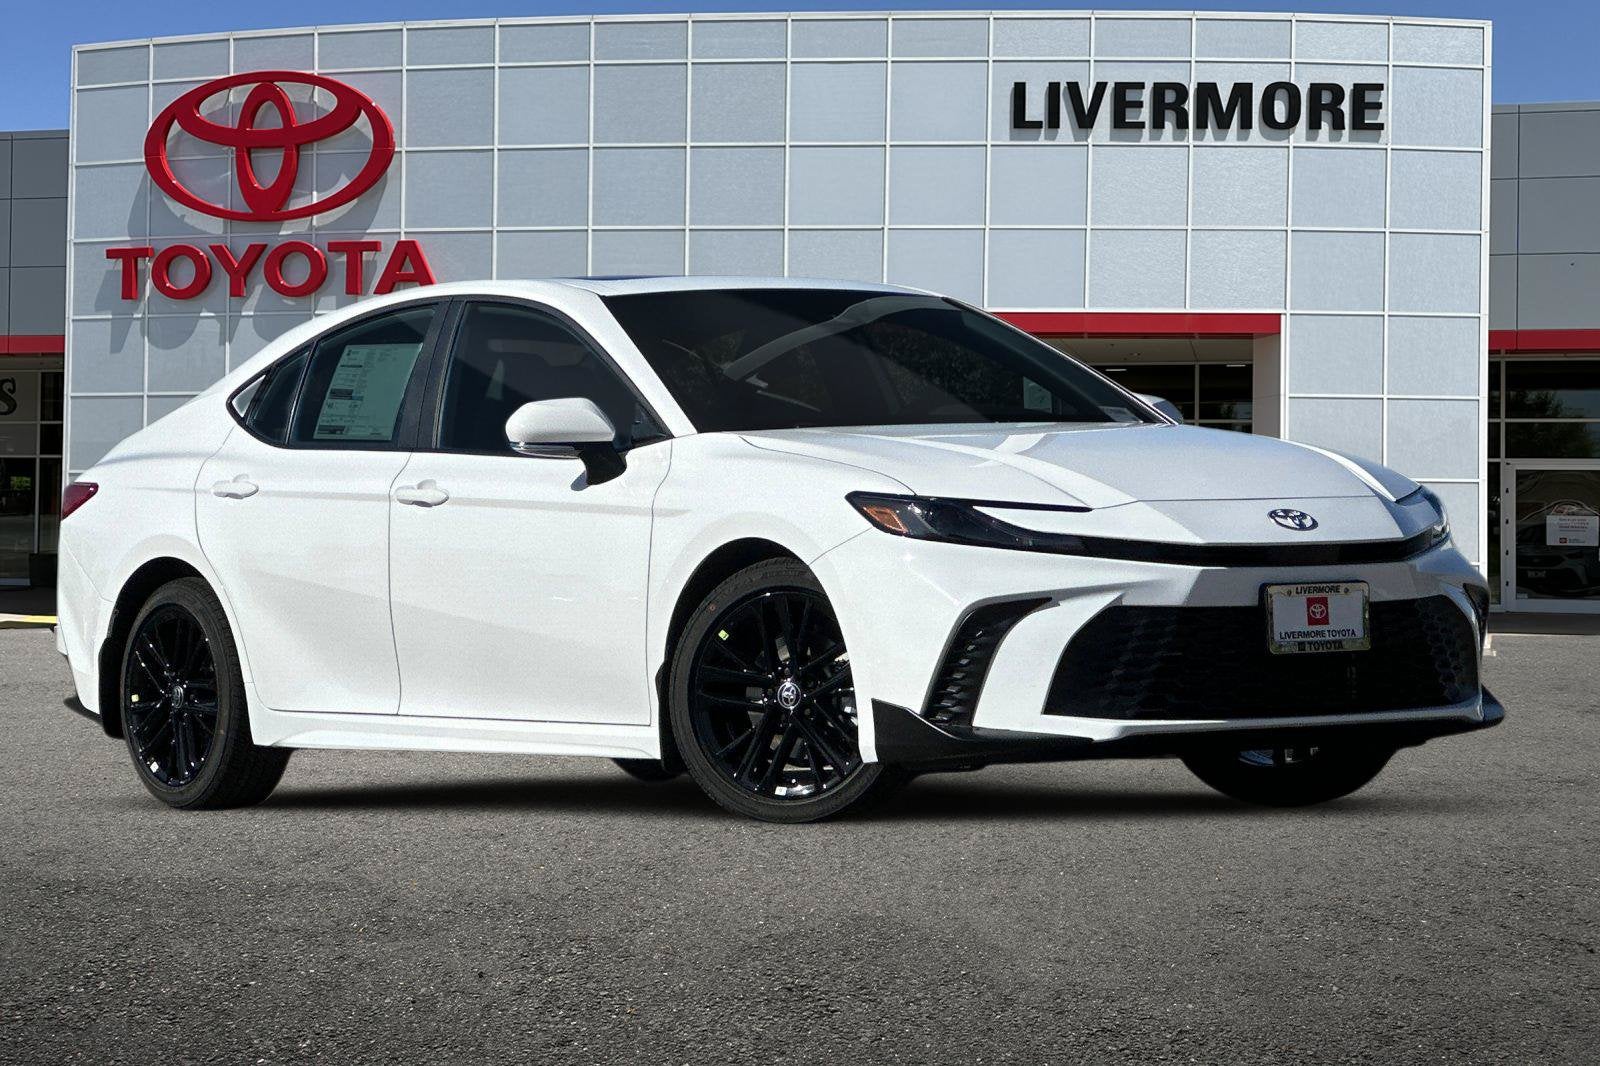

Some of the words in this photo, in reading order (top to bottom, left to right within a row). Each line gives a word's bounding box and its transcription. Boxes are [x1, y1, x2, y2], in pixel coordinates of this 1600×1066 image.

[1012, 81, 1385, 131] LIVERMORE
[105, 239, 437, 300] TOYOTA
[1295, 584, 1341, 595] LIVERMORE
[1279, 630, 1326, 640] LIVERMORE
[1327, 628, 1357, 638] TOYOTA
[1308, 640, 1344, 652] TOYOTA
